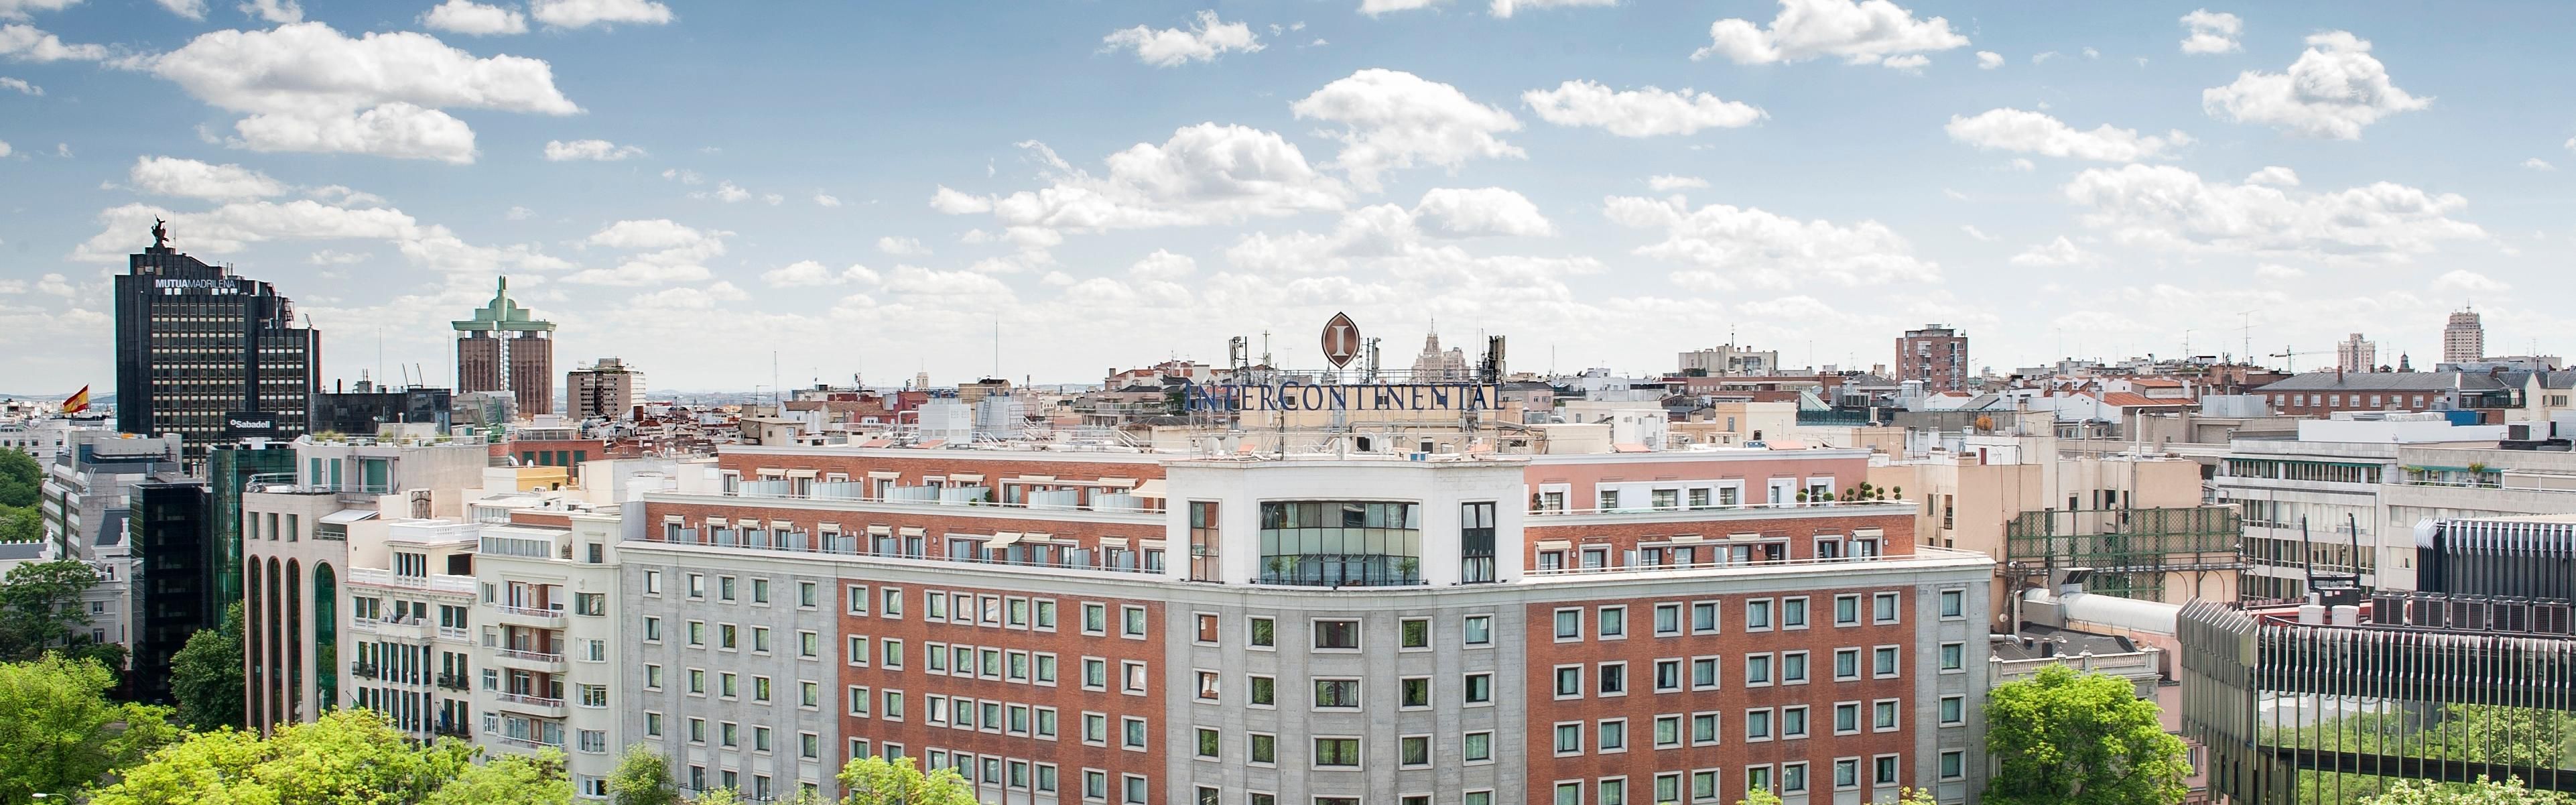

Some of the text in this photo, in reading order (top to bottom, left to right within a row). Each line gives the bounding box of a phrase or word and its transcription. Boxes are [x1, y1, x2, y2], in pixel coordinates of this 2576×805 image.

[1332, 325, 1349, 357] I
[1185, 379, 1505, 411] INTERCONTINENTAL
[235, 420, 270, 428] Sabadell
